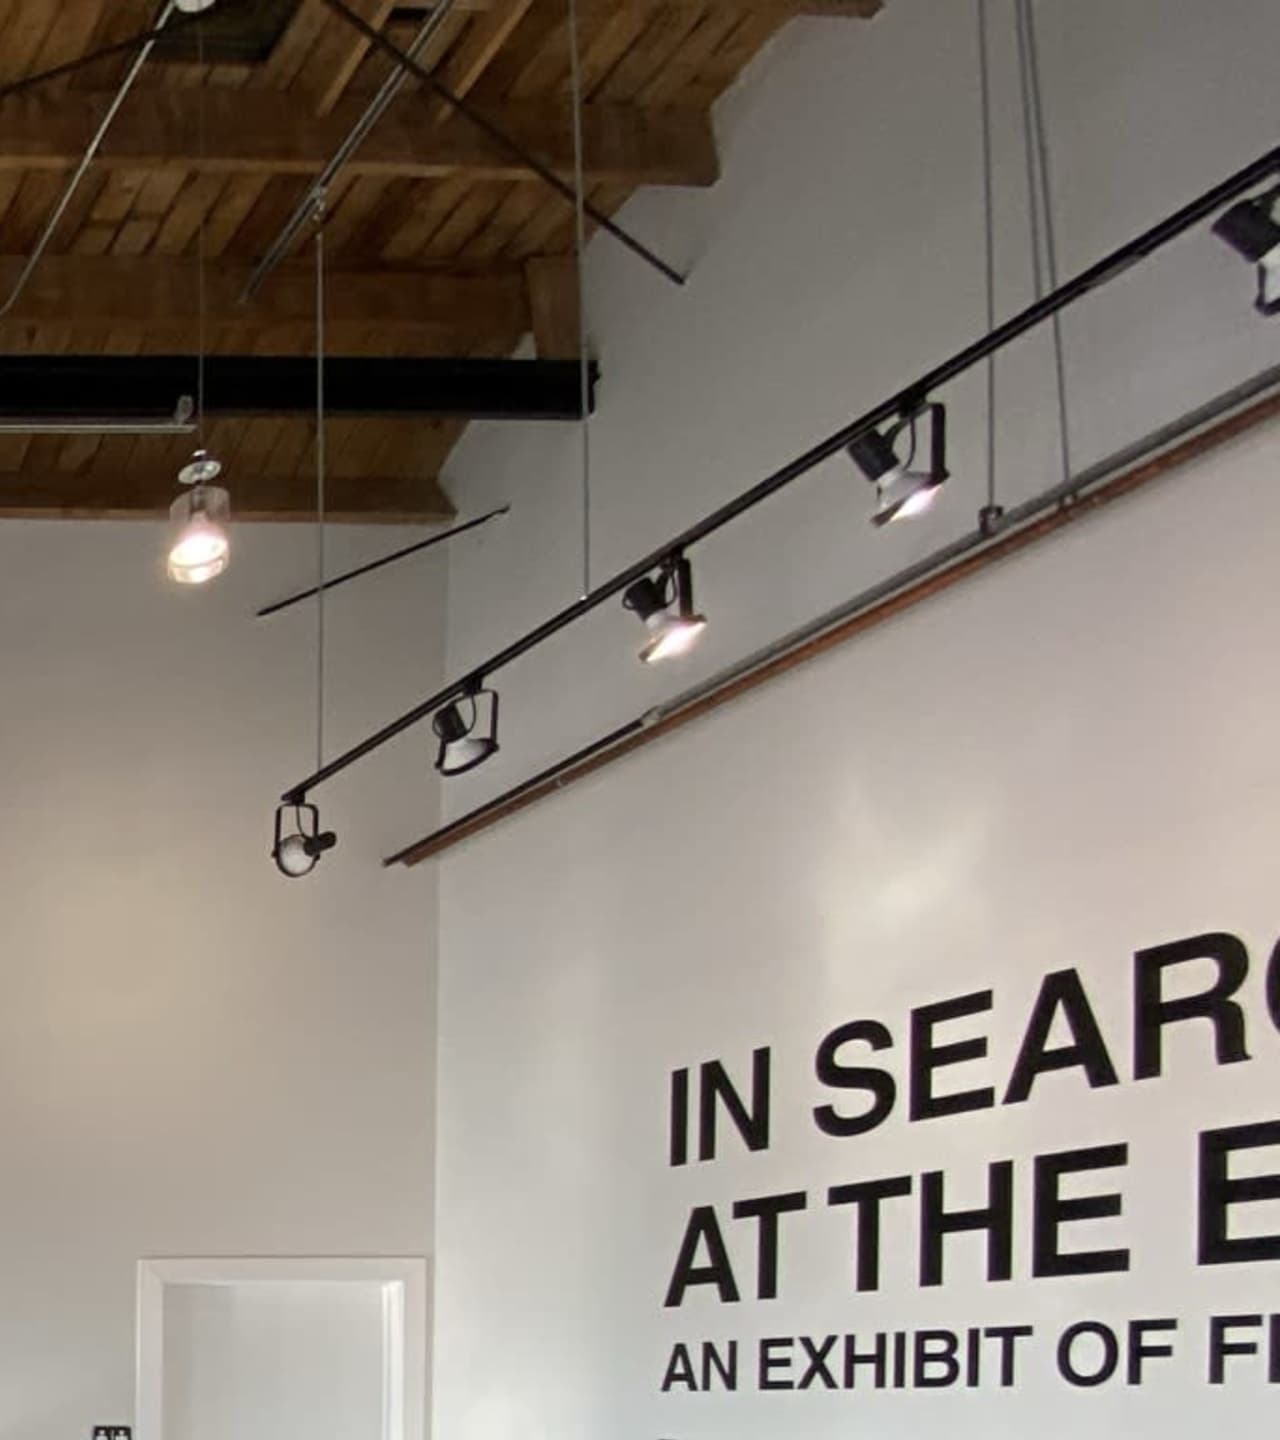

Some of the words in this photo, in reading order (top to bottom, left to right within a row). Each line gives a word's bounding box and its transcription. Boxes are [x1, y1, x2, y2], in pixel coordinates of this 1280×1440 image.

[669, 1046, 771, 1167] IN
[813, 931, 1280, 1138] SEAR
[664, 1191, 808, 1308] AT
[827, 1142, 1130, 1293] THE
[661, 1340, 738, 1392] AN
[758, 1325, 1034, 1391] EXHIBIT
[1056, 1318, 1178, 1388] OF
[1208, 1313, 1280, 1385] F
